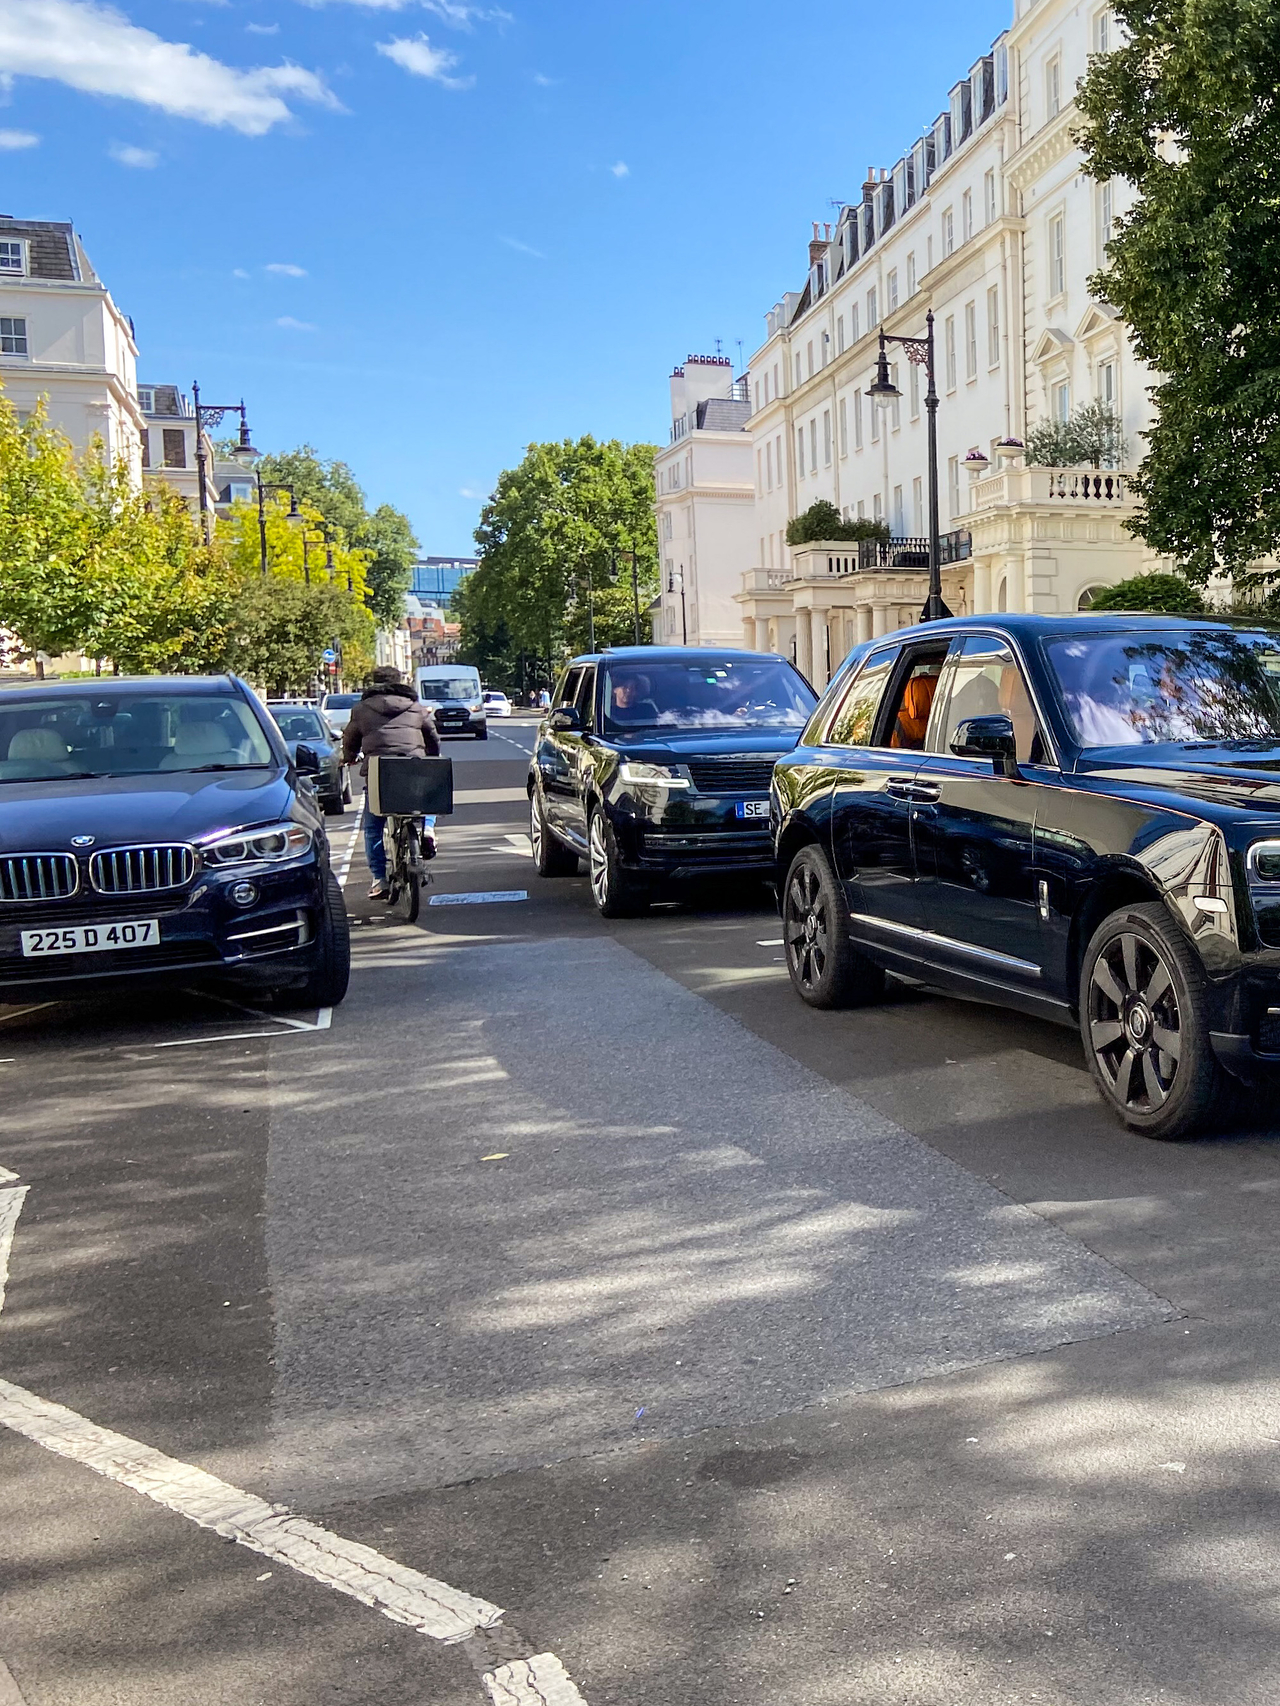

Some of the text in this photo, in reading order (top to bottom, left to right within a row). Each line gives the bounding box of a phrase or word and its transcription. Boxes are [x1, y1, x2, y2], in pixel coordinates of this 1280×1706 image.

[746, 803, 763, 815] SE
[29, 923, 152, 952] 225 D 407
